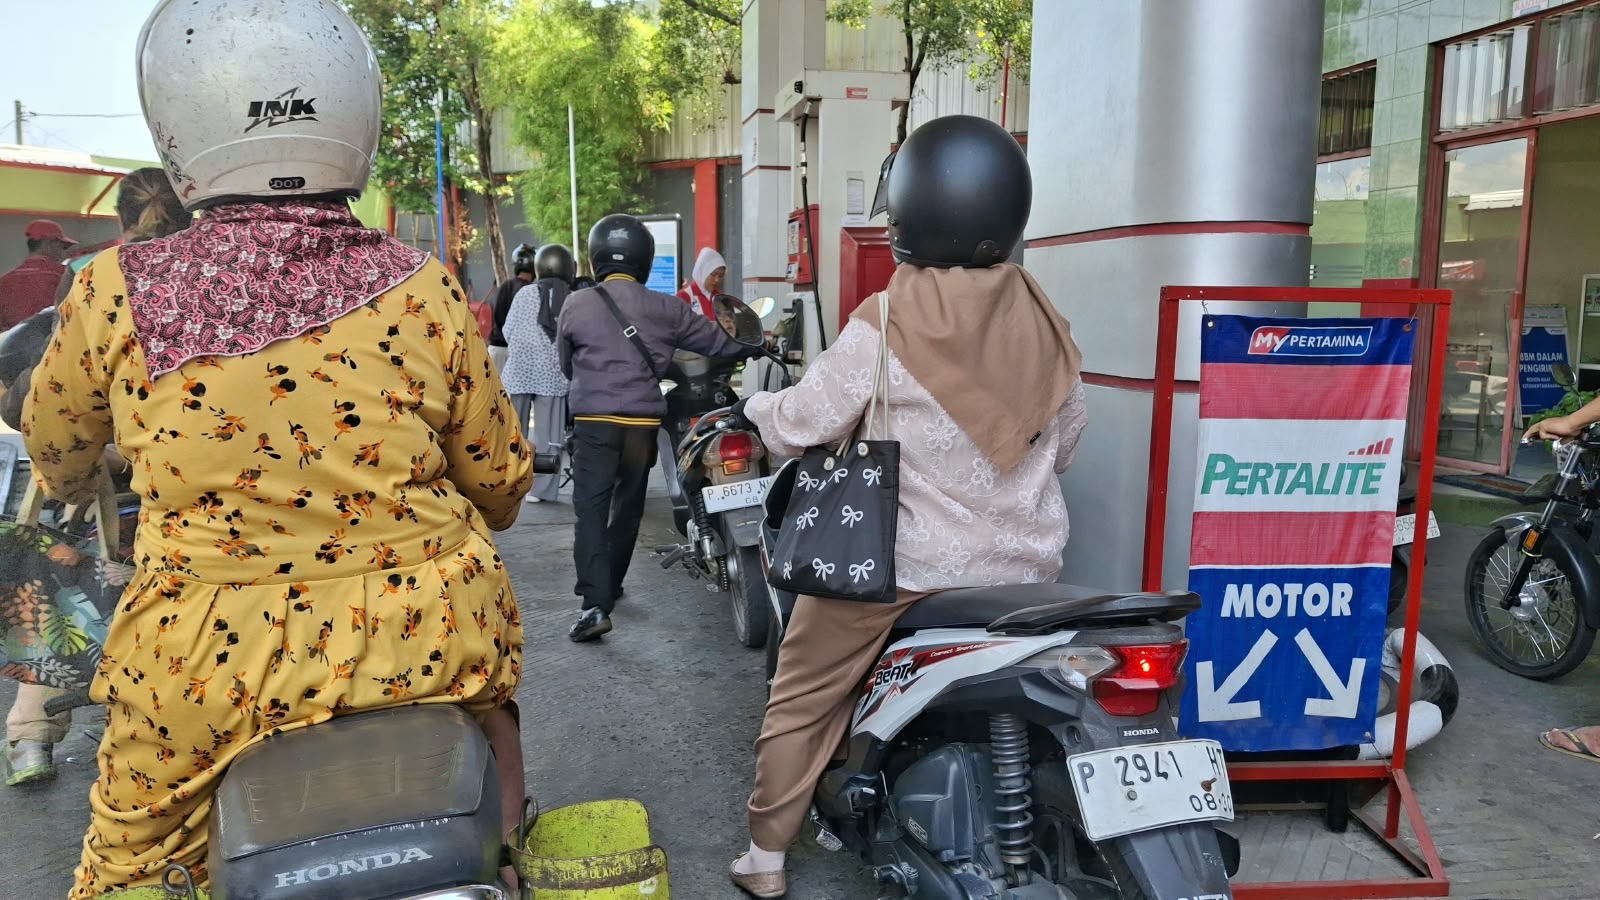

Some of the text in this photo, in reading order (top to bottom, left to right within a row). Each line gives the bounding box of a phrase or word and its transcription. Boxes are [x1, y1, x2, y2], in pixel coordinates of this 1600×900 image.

[247, 97, 317, 117] INK
[274, 178, 300, 188] DOT
[1289, 335, 1365, 348] PERTAMINA
[1536, 352, 1563, 361] DALAM
[1200, 453, 1387, 495] PERTALITE
[707, 479, 769, 500] P 6673 N
[1220, 582, 1353, 618] MOTOR
[1123, 727, 1159, 737] HONDA
[1077, 761, 1095, 794] P
[1114, 750, 1182, 786] 2941
[275, 847, 433, 889] HONDA
